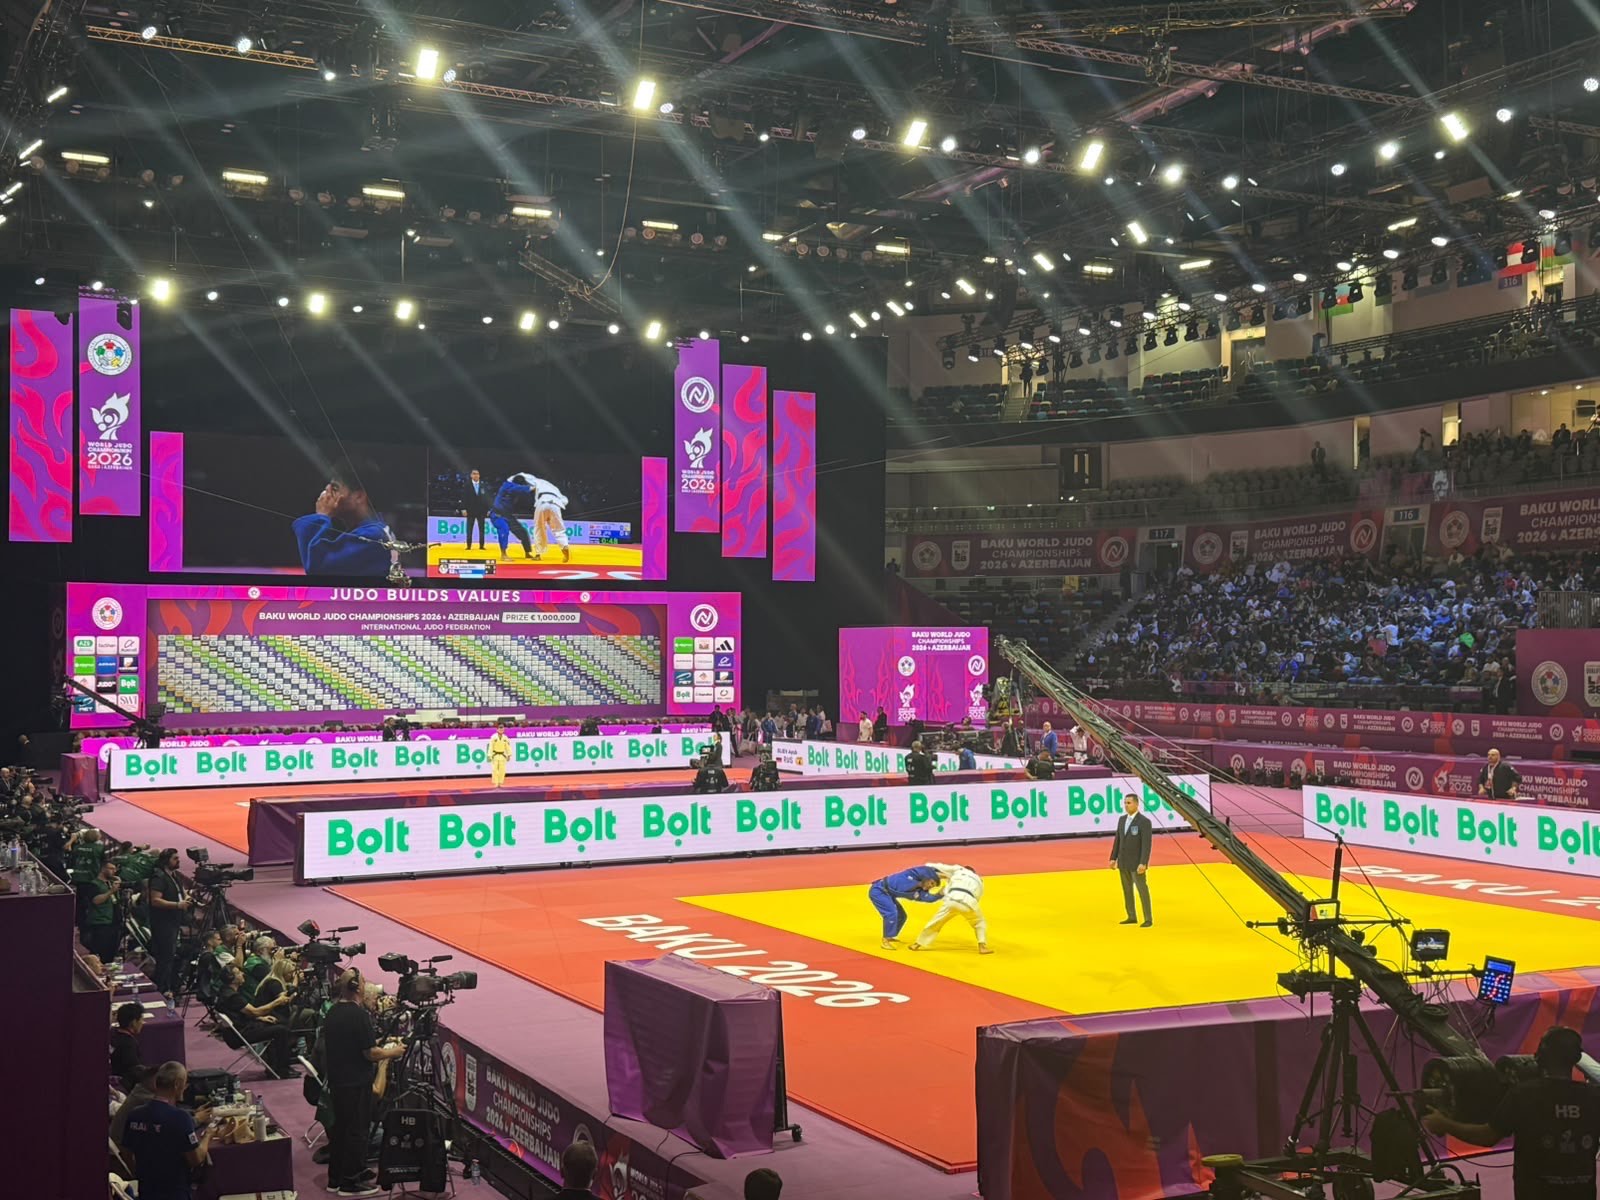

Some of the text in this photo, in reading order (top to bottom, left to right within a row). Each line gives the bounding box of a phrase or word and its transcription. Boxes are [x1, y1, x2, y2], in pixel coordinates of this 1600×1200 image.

[87, 452, 133, 466] 2026
[681, 478, 715, 490] 2026
[1520, 502, 1557, 516] BAKU
[437, 520, 465, 538] Bol
[1254, 520, 1346, 540] BAKU WORLD JUDO
[981, 537, 1093, 549] BAKU WORLD JUDO
[1262, 535, 1335, 549] CHAMPIONSHIPS
[1517, 531, 1547, 543] 2026
[992, 548, 1081, 559] CHAMPIONSHIPS
[980, 558, 1092, 570] 2026 AZERBAIJAN
[330, 588, 521, 602] JUDO BUILDS VALUES
[259, 612, 286, 620] BAKU
[288, 612, 321, 620] WORLD
[323, 613, 347, 621] JUDO
[349, 613, 420, 621] CHAMPIONSHIPS
[126, 753, 178, 782] Bolt
[197, 751, 247, 780] Bolt
[265, 749, 314, 777] Bolt
[331, 747, 379, 775] Bolt
[395, 745, 440, 772] Bolt
[456, 743, 491, 769] Bol
[515, 742, 558, 767] Bolt
[573, 740, 614, 765] Bolt
[628, 738, 668, 763] Bolt
[808, 745, 829, 772] Bolt
[836, 748, 858, 773] Bolt
[865, 750, 889, 773] Bolt
[1333, 761, 1396, 772] BAKU WORLD JUDO
[1340, 770, 1390, 780] CHAMPIONSHIPS
[1522, 775, 1588, 787] KU WORLD JUDO
[1449, 782, 1473, 792] 2026
[1518, 784, 1580, 795] CHAMPIONSHIPS
[327, 816, 409, 866] Bolt
[439, 811, 516, 859] Bolt
[544, 806, 617, 853] Bolt
[643, 802, 712, 847] Bolt
[736, 797, 802, 842] Bolt
[825, 794, 887, 837] Bolt
[910, 791, 969, 833] Bolt
[990, 788, 1048, 829] Bolt
[1068, 784, 1124, 824] Bolt
[1315, 792, 1367, 836] Bolt
[1383, 799, 1440, 845] Bolt
[1457, 807, 1519, 855] Bolt
[1340, 865, 1561, 896] BAKU
[578, 914, 911, 1008] BAKU 2026
[486, 1065, 560, 1125] BAKU WORLD JUDO
[493, 1091, 551, 1142] CHAMPIONSHIPS
[1555, 1104, 1581, 1119] HB
[486, 1106, 560, 1171] 2026 AZERBAIJAN
